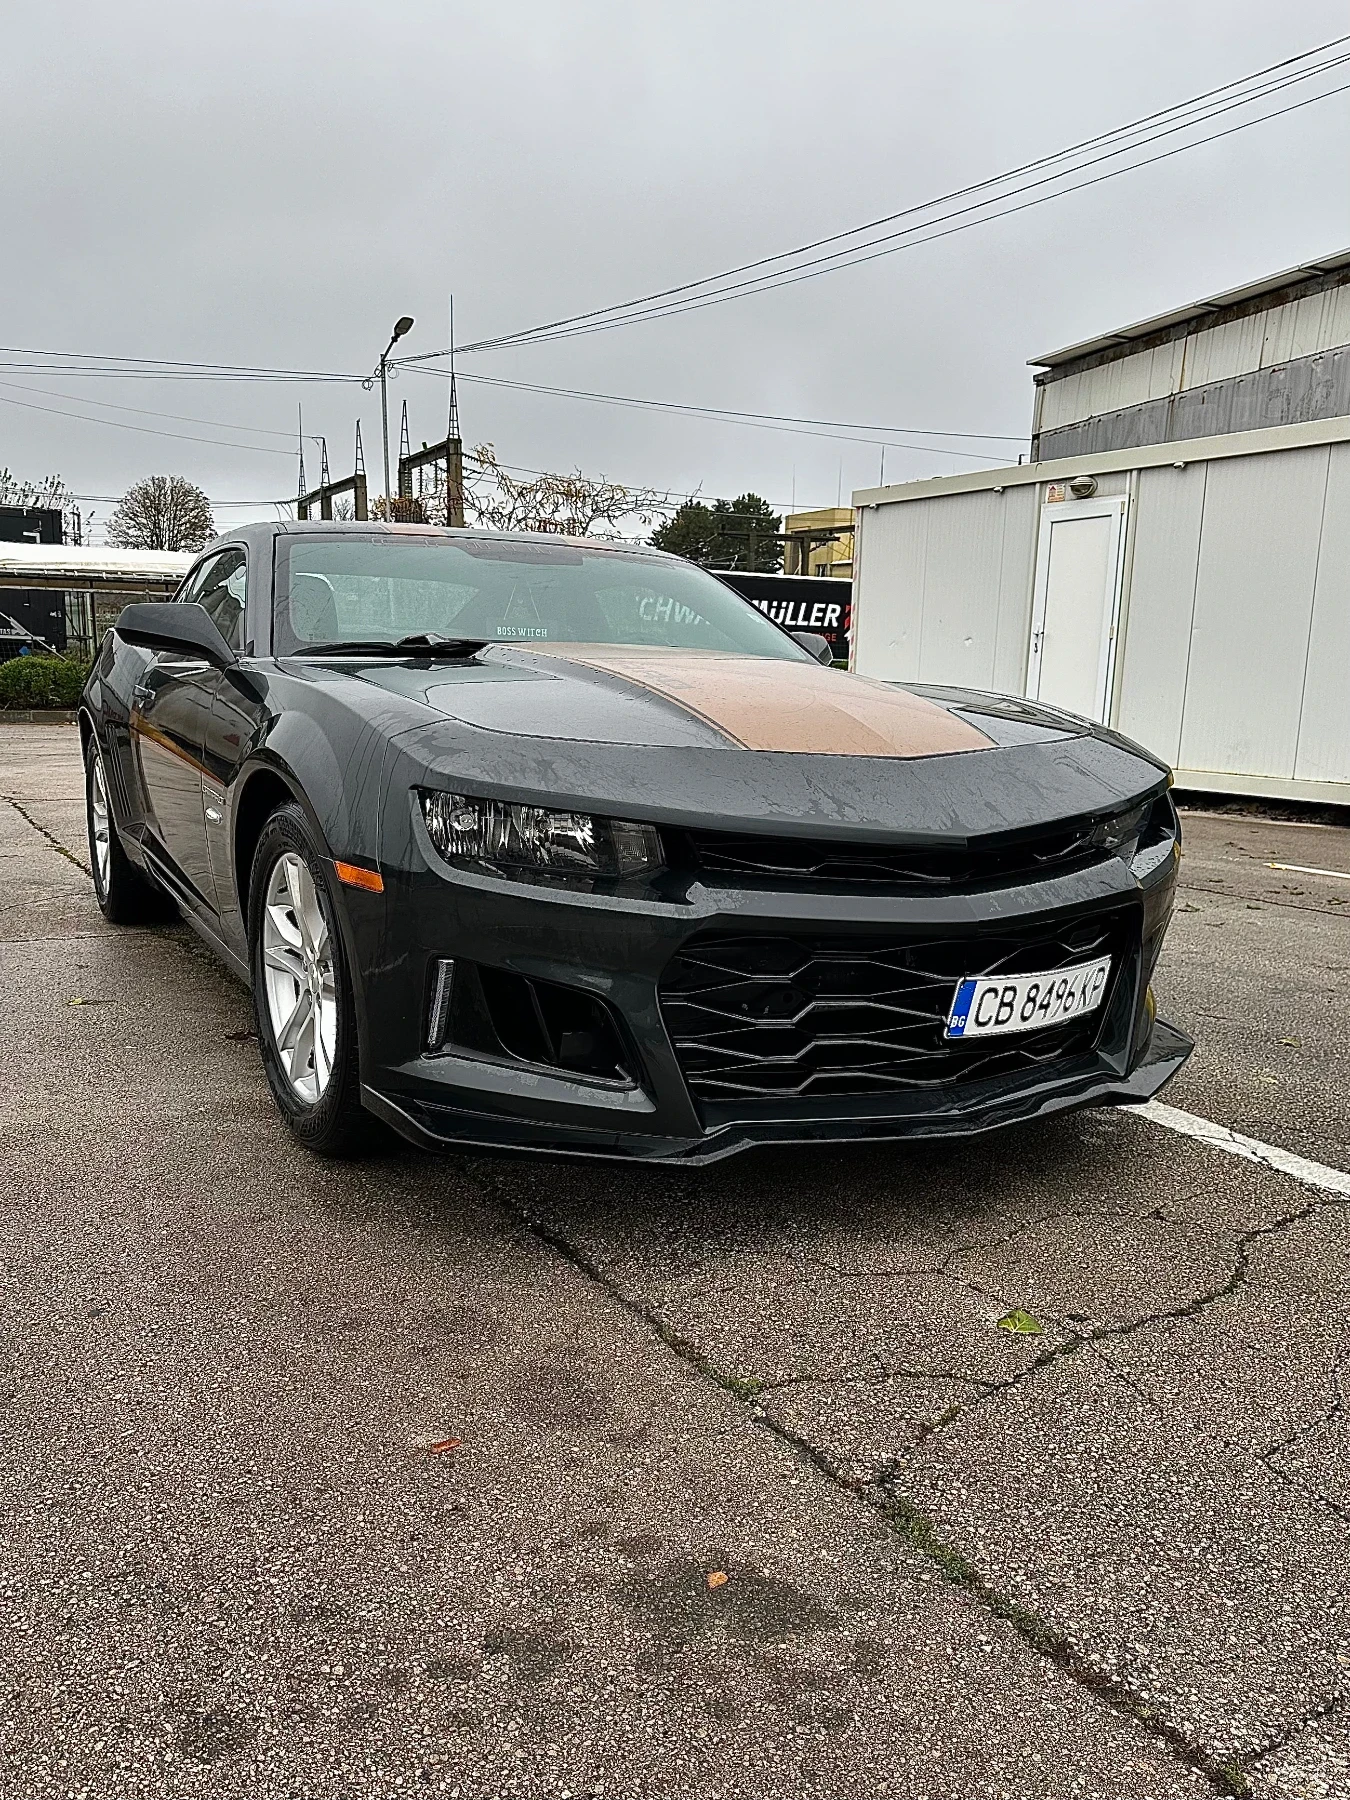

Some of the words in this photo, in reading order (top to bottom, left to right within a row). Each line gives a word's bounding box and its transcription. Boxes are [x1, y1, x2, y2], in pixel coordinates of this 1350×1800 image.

[497, 626, 516, 636] BOSS
[518, 627, 548, 637] WITCH
[974, 985, 1017, 1027] CB
[1019, 973, 1081, 1023] 8496
[1076, 966, 1105, 1009] KP
[950, 1015, 966, 1028] BG
